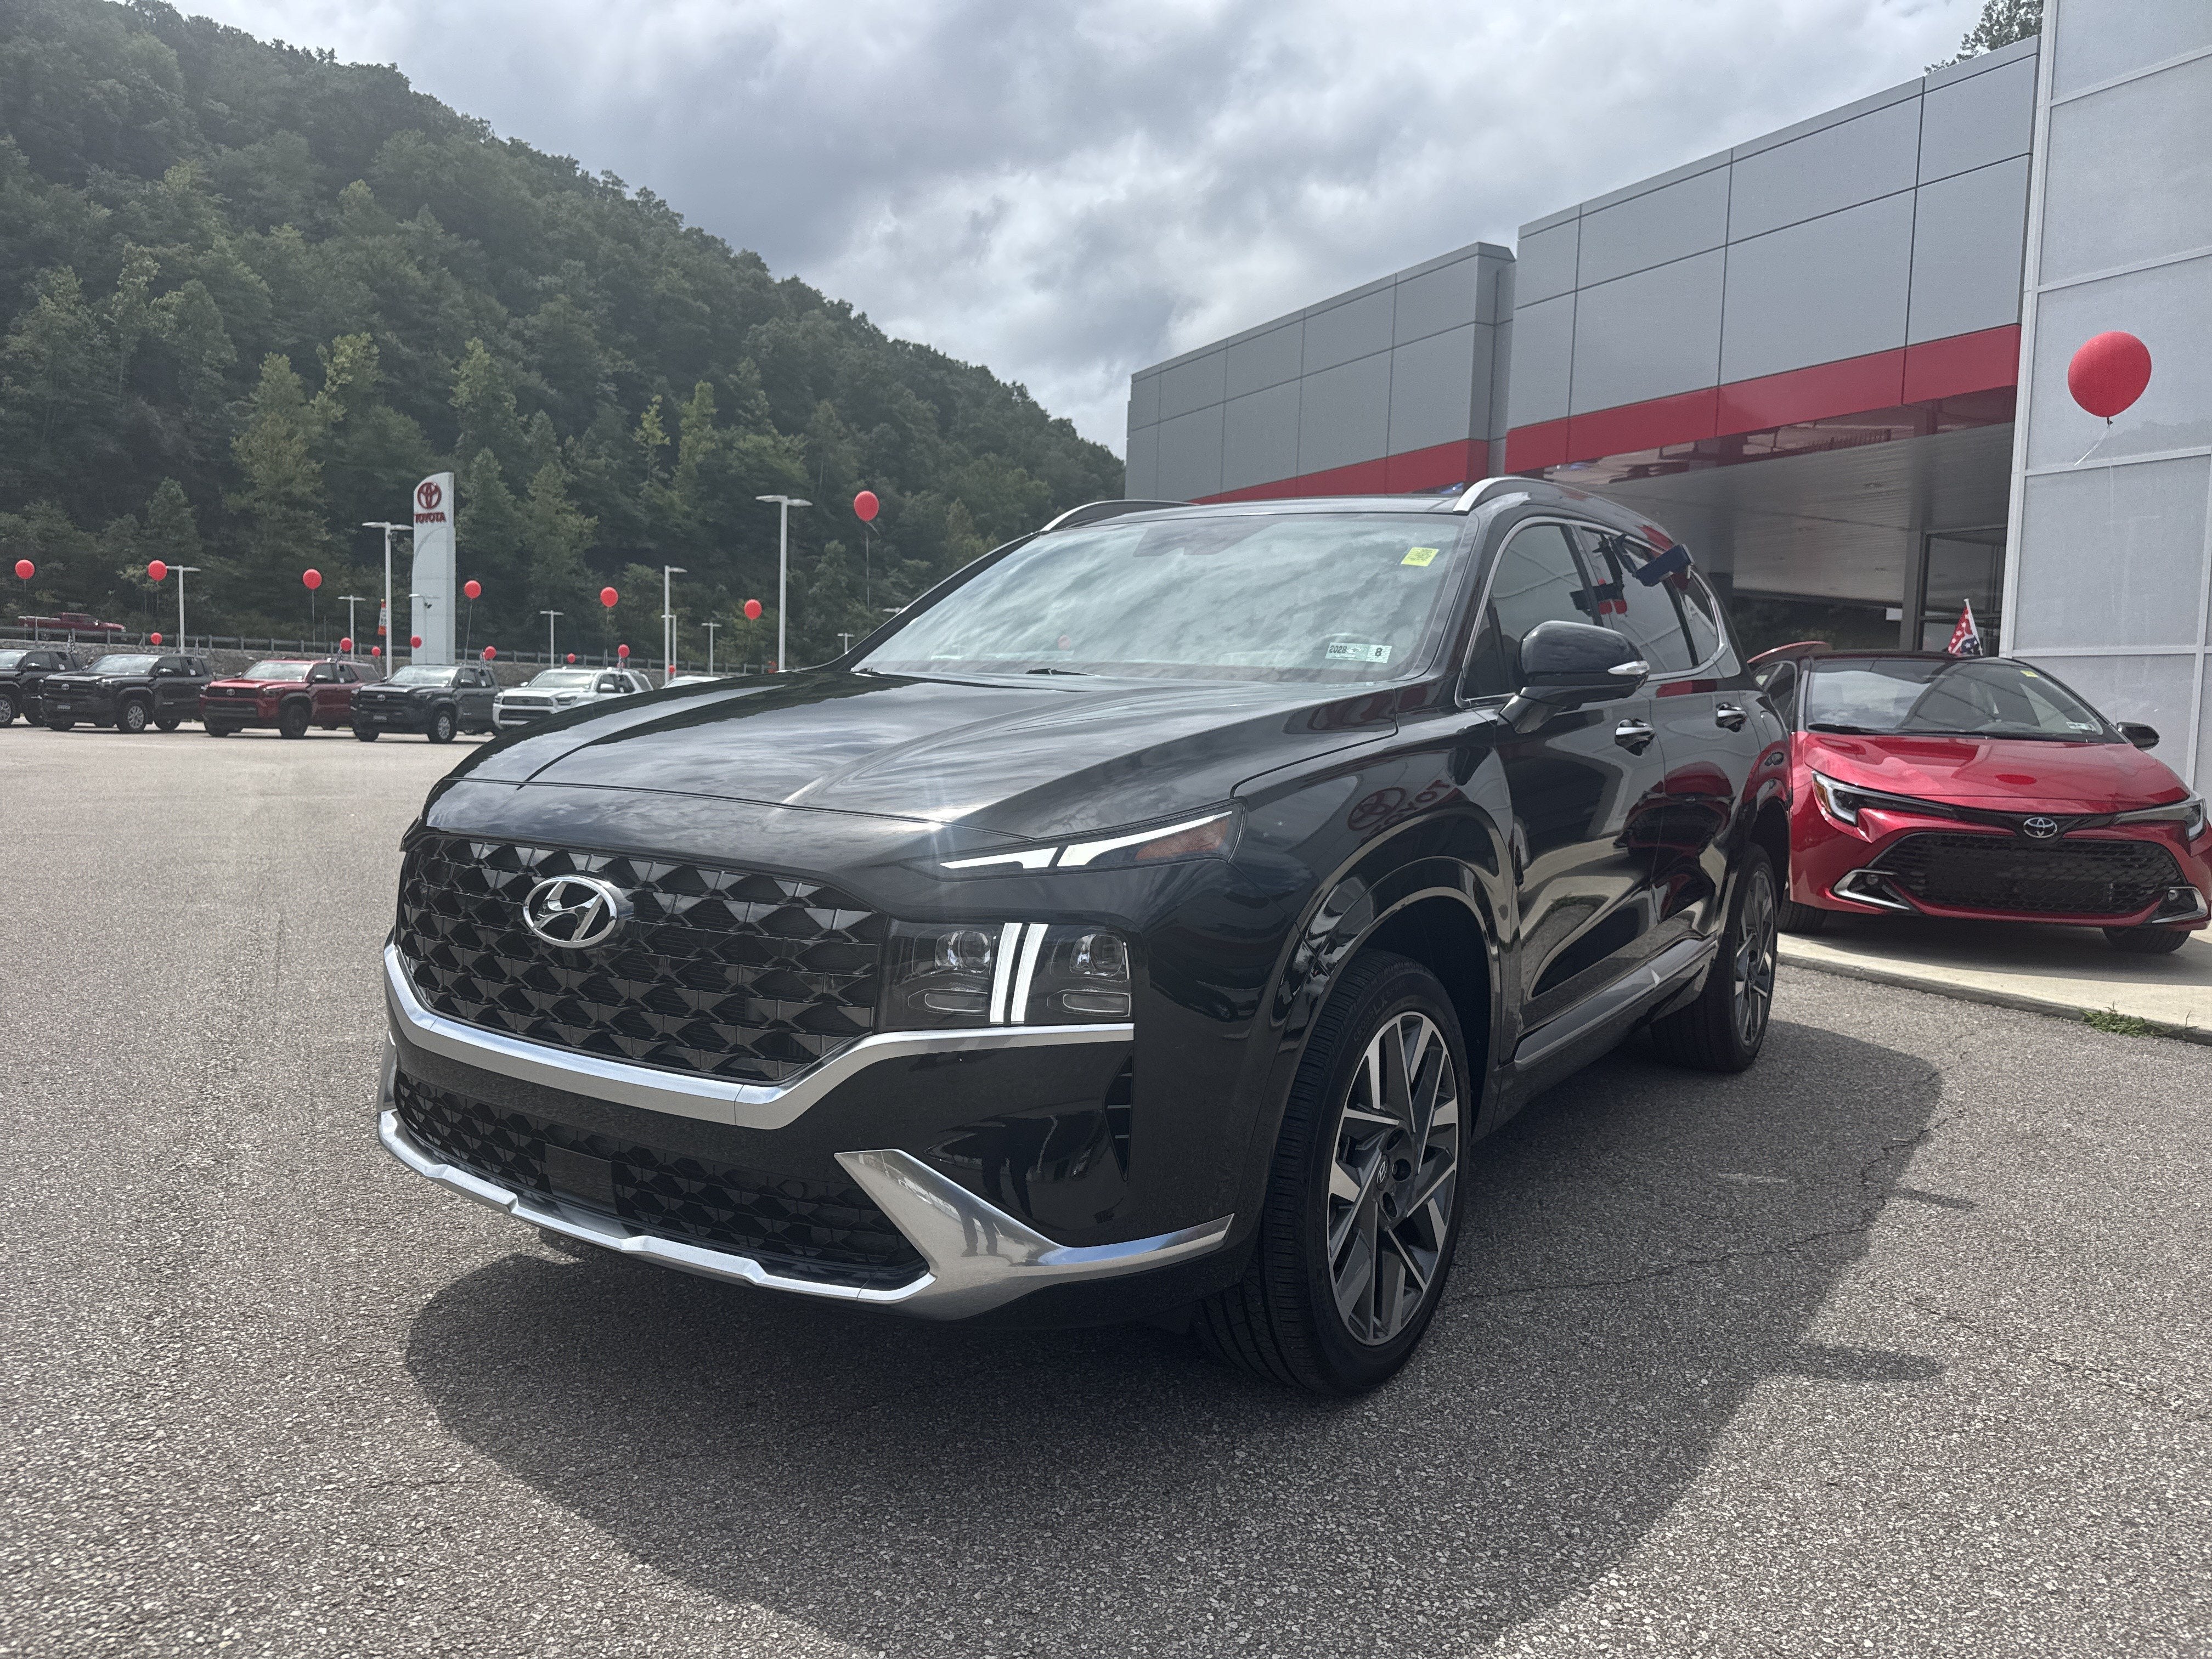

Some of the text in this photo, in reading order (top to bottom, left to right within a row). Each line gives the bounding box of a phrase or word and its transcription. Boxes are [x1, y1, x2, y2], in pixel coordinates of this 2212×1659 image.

[414, 512, 447, 523] TOYOTA
[1328, 645, 1383, 657] 2028 8
[1353, 1008, 1374, 1042] CROSS
[1373, 993, 1389, 1015] LX
[1385, 979, 1405, 997] SPORT
